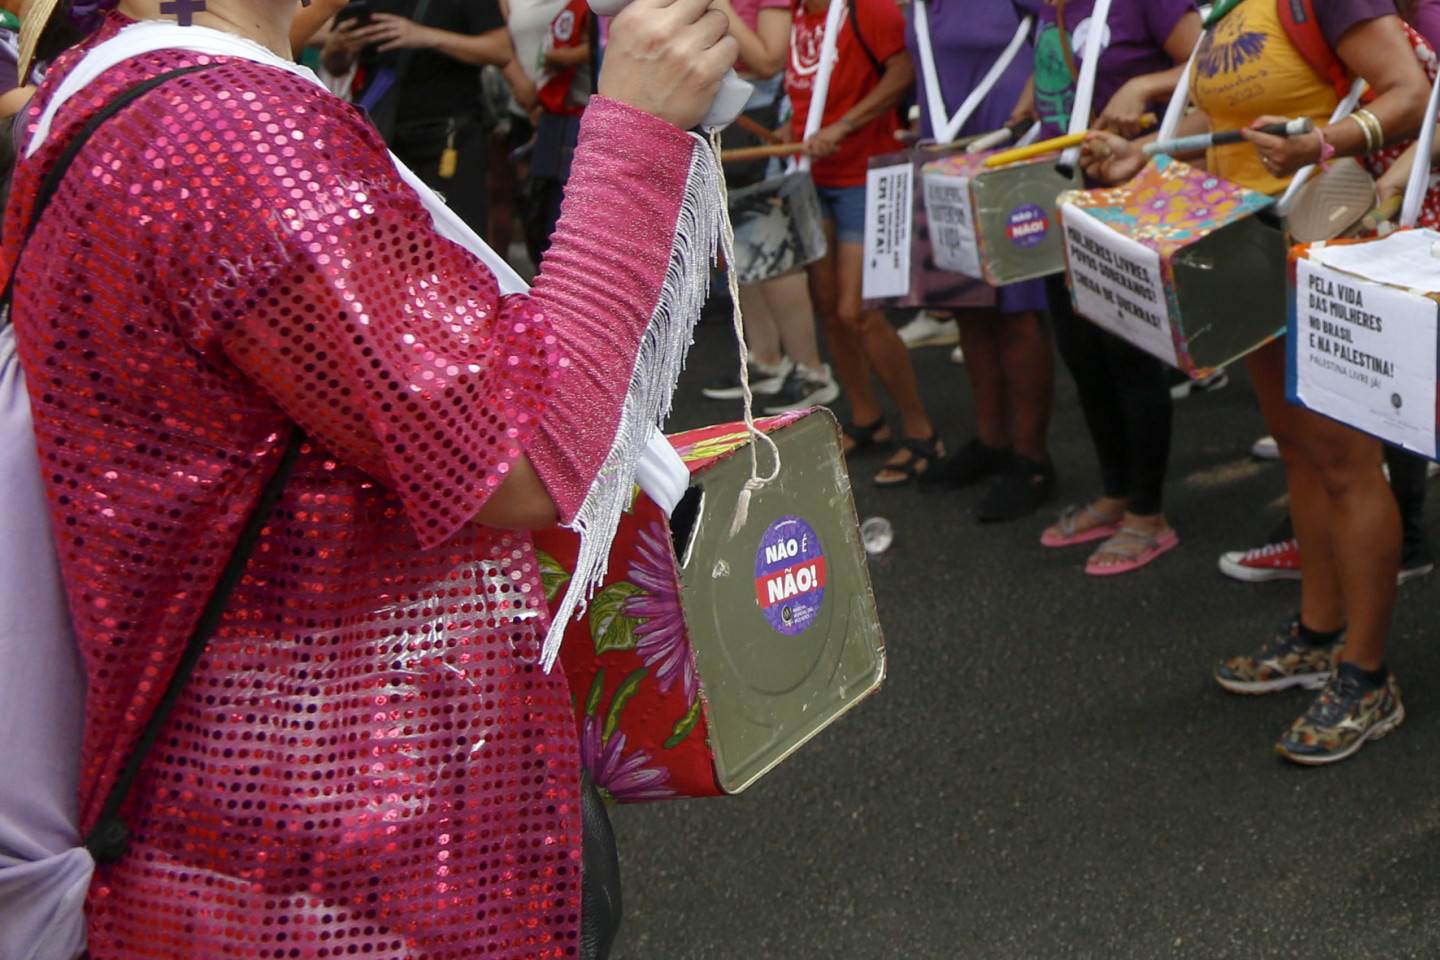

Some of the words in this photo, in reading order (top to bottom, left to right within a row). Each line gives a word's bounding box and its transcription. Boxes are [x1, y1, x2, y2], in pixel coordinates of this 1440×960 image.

[1308, 273, 1334, 298] PELA
[1337, 283, 1364, 308] VIDA
[1308, 293, 1328, 314] DAS
[1330, 301, 1383, 333] MULHERES
[1309, 315, 1321, 331] NO
[1322, 320, 1353, 344] BRASIL
[1309, 332, 1316, 348] E
[1318, 338, 1331, 355] NA
[1333, 342, 1395, 378] PALESTINA!
[1309, 354, 1347, 376] PALESTINA
[1349, 370, 1369, 385] LIVRE
[765, 537, 798, 565] NÃO
[802, 533, 808, 553] É
[767, 565, 818, 604] NÃO!
